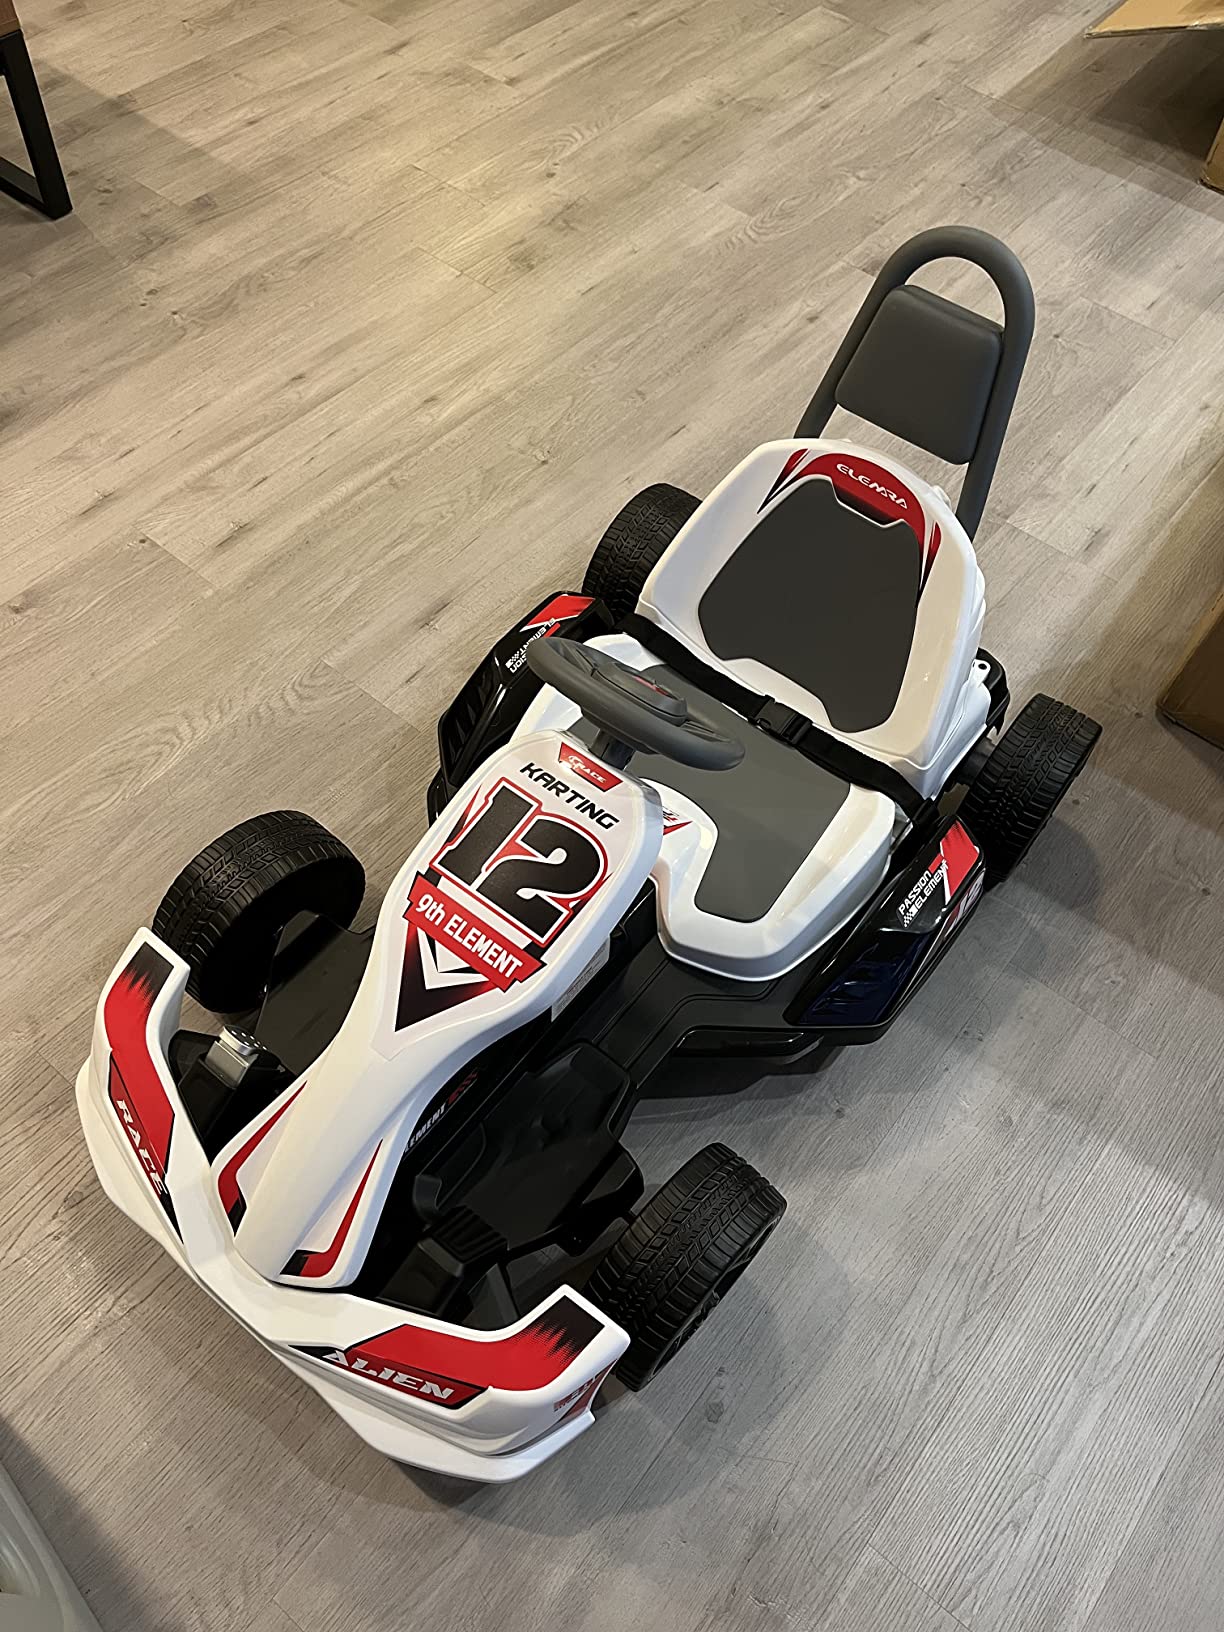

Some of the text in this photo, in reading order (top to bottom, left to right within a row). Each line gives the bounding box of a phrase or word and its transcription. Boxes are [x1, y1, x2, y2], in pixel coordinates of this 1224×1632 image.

[519, 762, 620, 830] KARTING
[434, 783, 604, 941] 12
[898, 869, 933, 916] PASSION
[914, 858, 949, 910] ELEMENT
[415, 893, 524, 978] 9th ELEMENT
[116, 1099, 169, 1195] RACE
[321, 1349, 456, 1400] ALIEN
